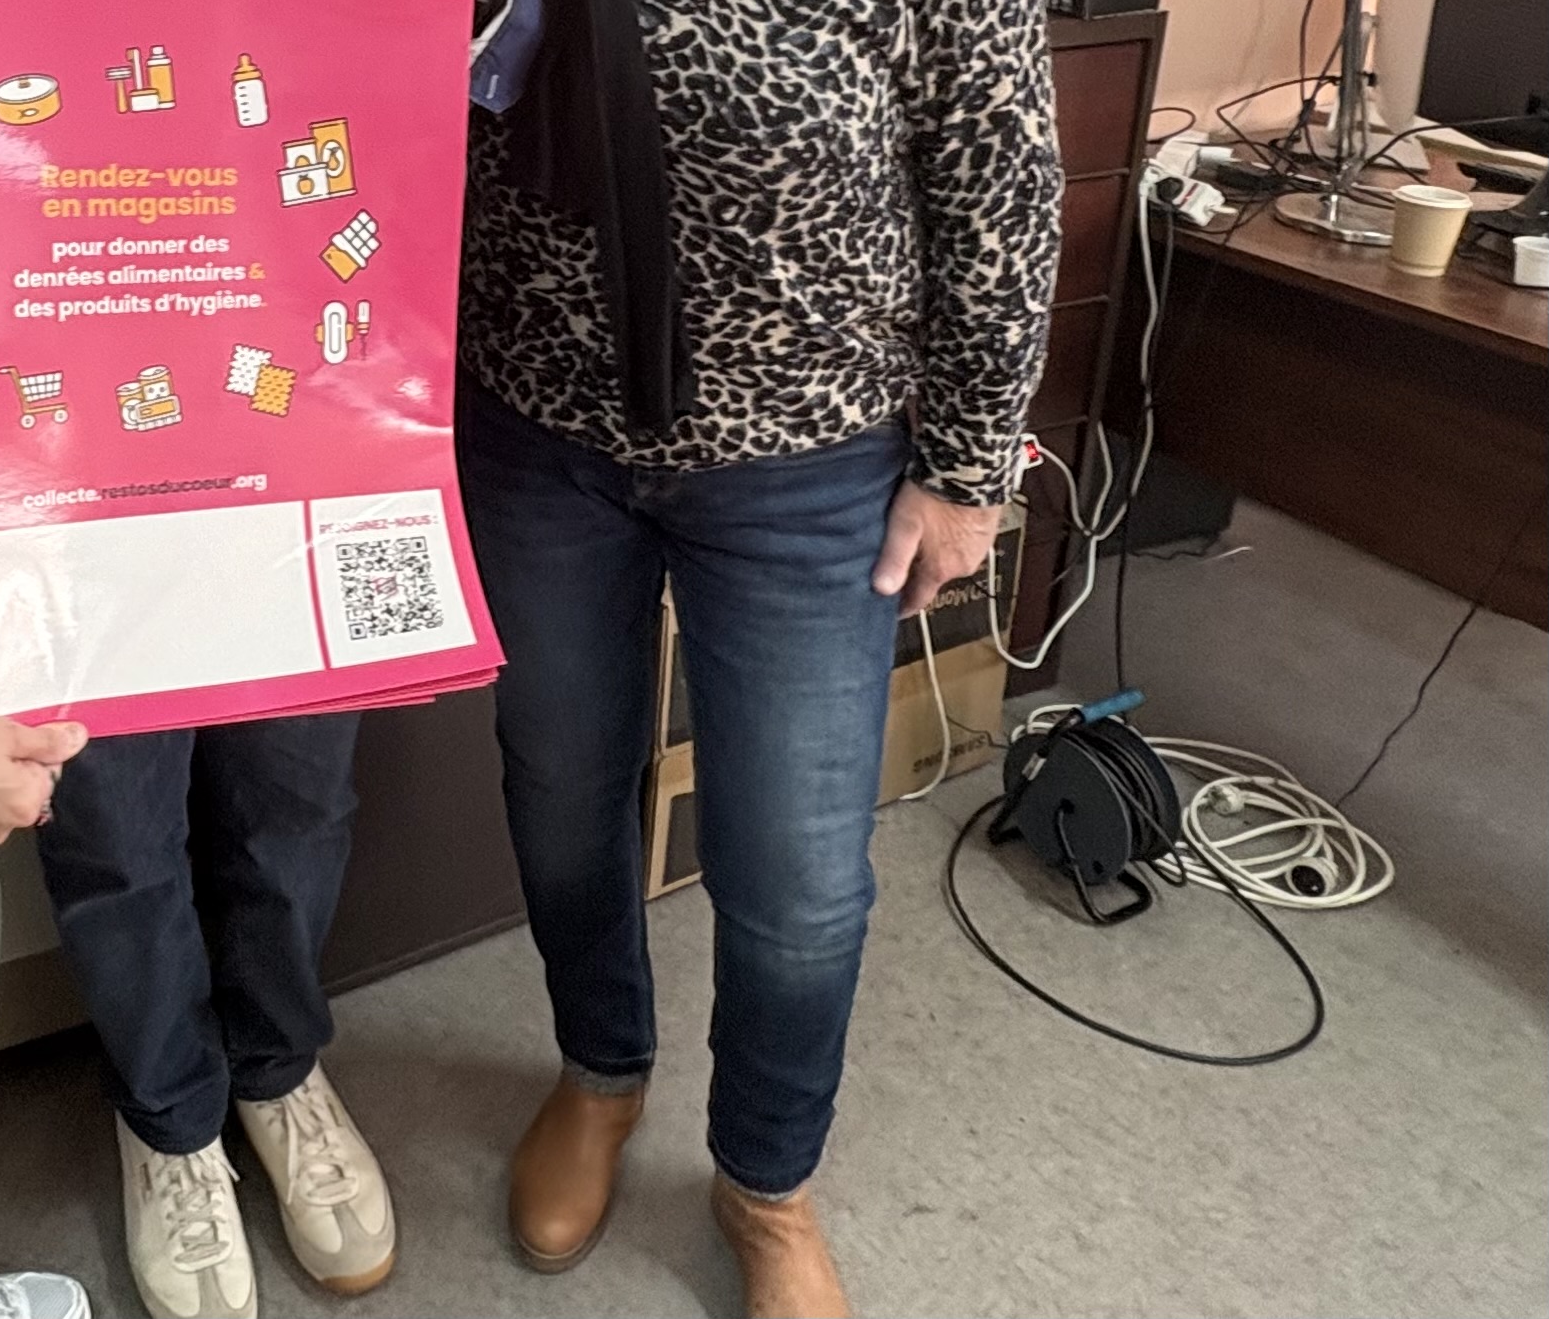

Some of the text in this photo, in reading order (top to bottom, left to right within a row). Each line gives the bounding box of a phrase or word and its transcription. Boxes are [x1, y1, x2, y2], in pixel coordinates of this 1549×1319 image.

[41, 164, 238, 188] Rendez-vous
[42, 190, 237, 224] en magasins
[52, 235, 230, 263] pour donner des
[14, 262, 266, 288] denrées alimentaires &
[14, 299, 56, 318] des
[58, 294, 152, 322] produits
[22, 474, 267, 508] collecte.restosducoeur.org
